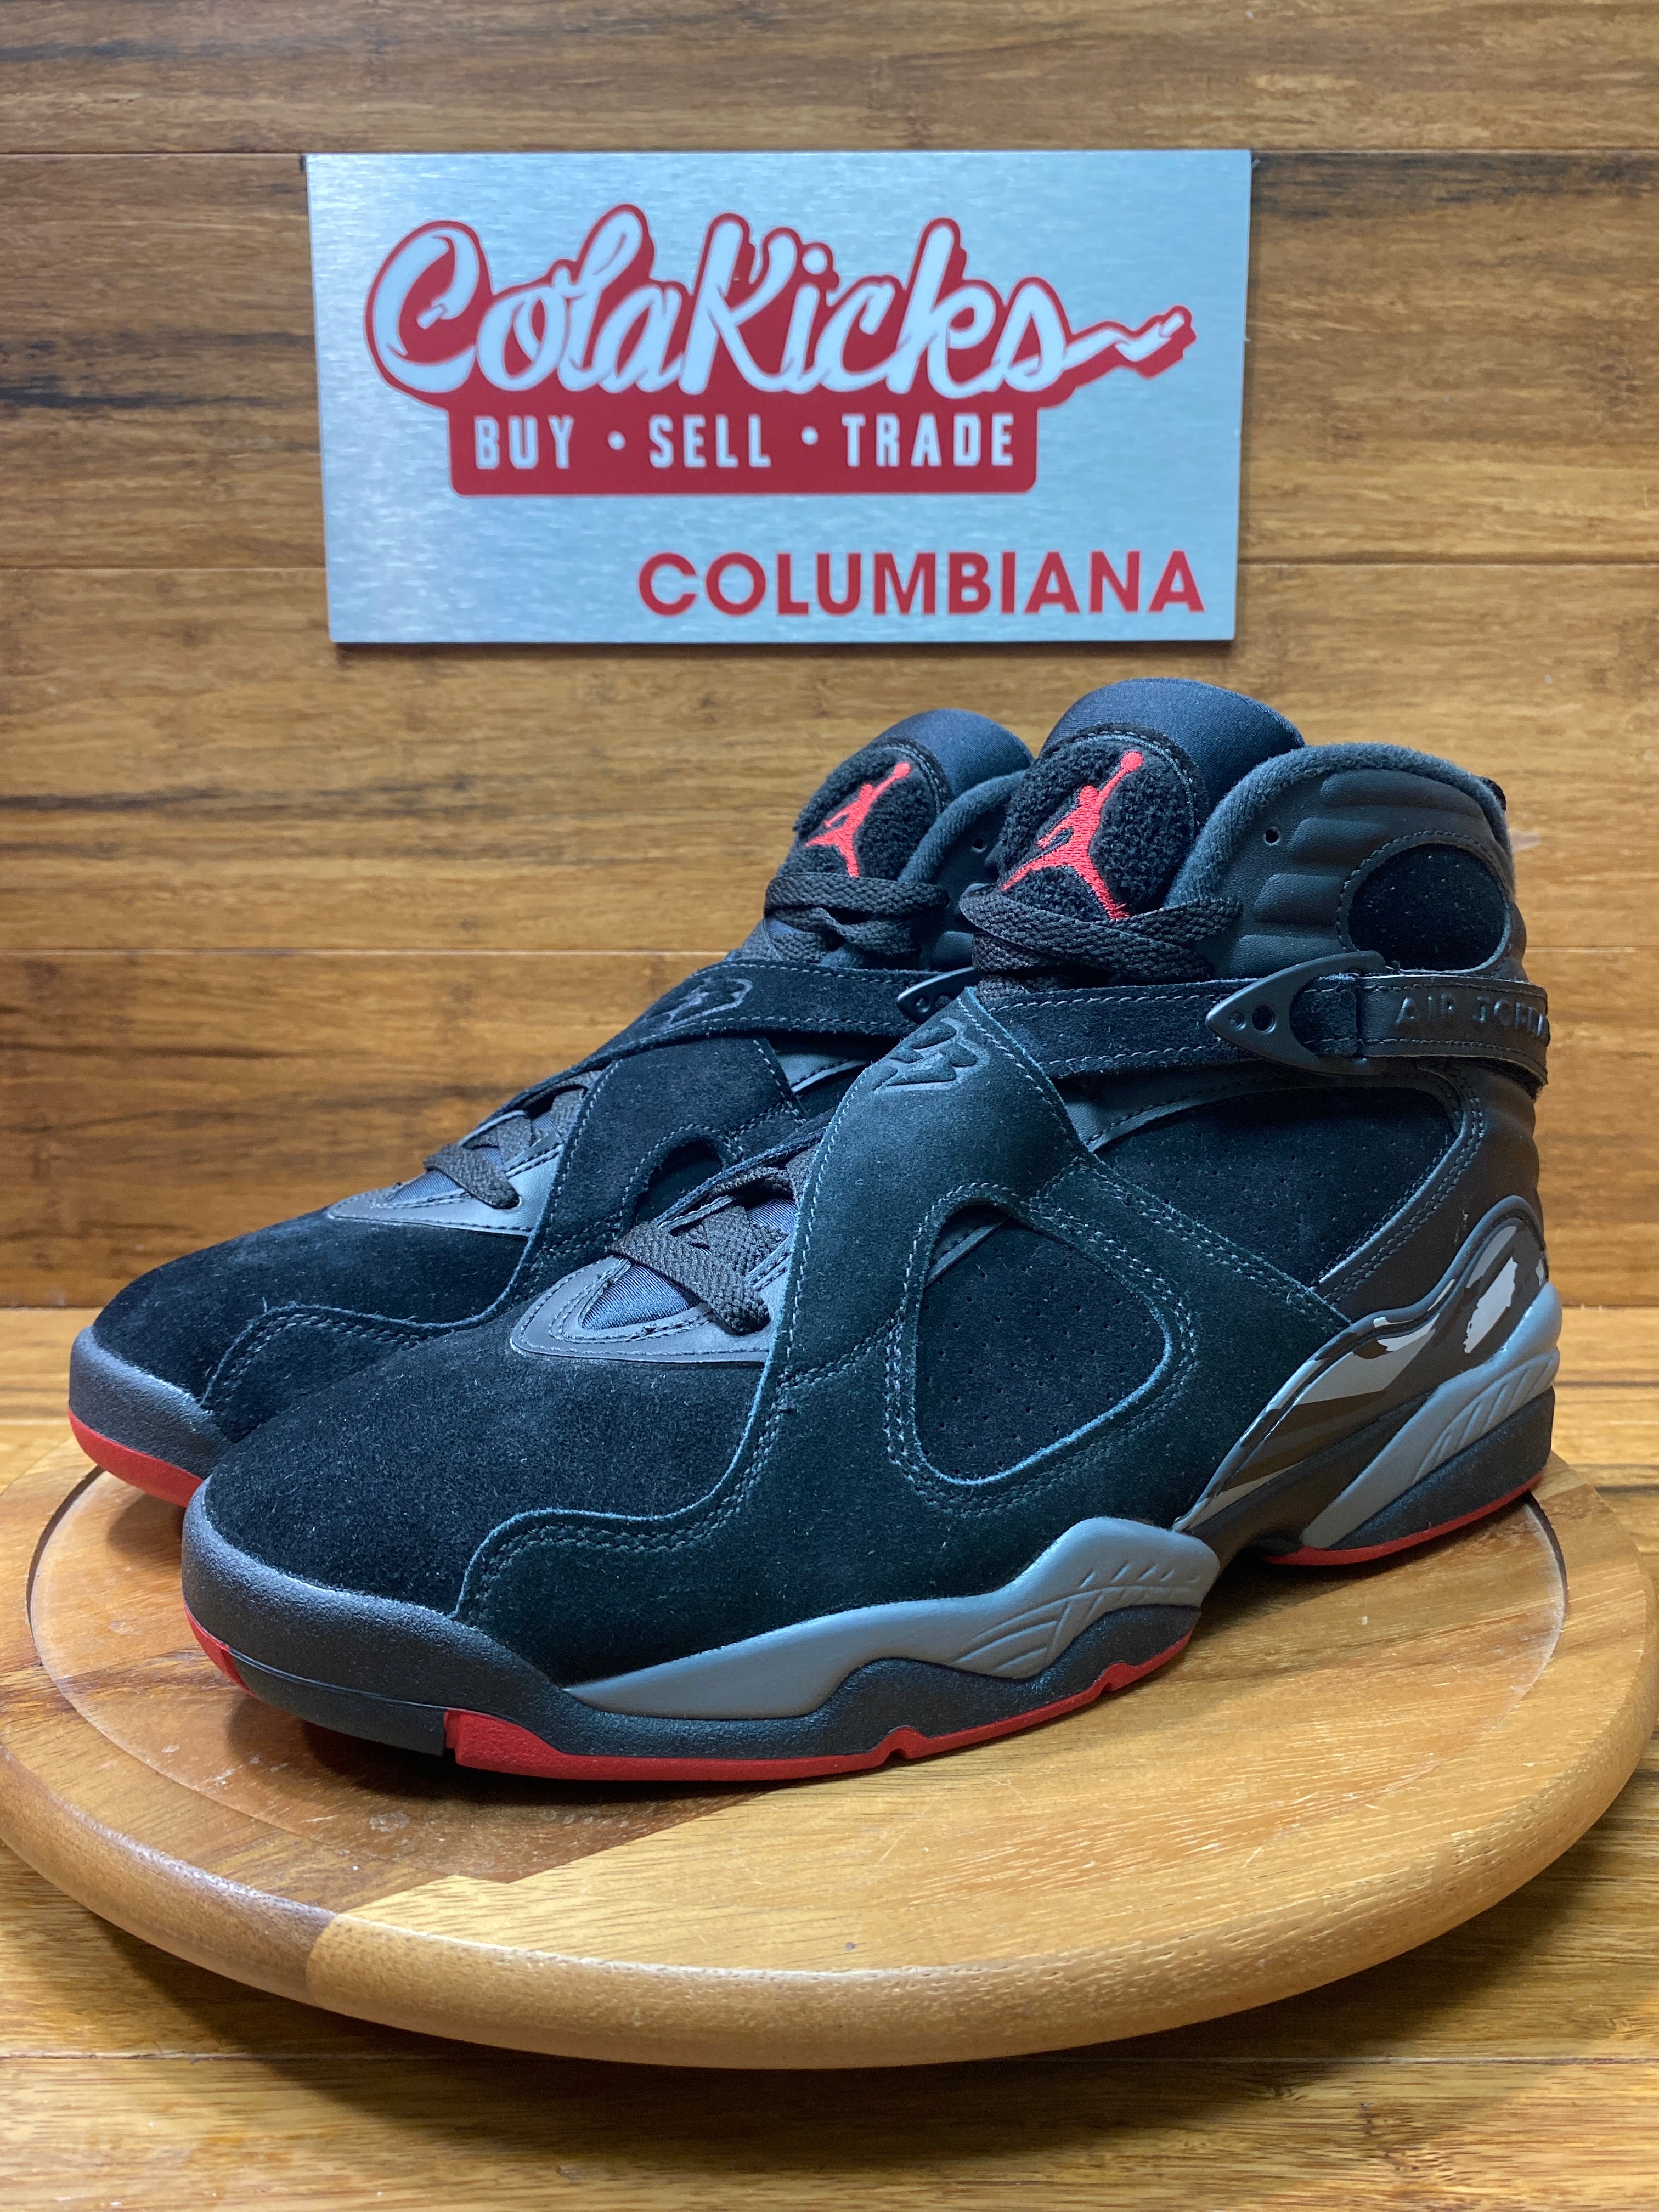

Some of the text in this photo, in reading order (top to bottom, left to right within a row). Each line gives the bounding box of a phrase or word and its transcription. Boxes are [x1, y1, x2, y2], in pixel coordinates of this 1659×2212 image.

[473, 413, 1014, 470] BUY SELL TRADE
[638, 550, 1204, 616] COLUMBIANA
[1395, 992, 1456, 1025] AIR
